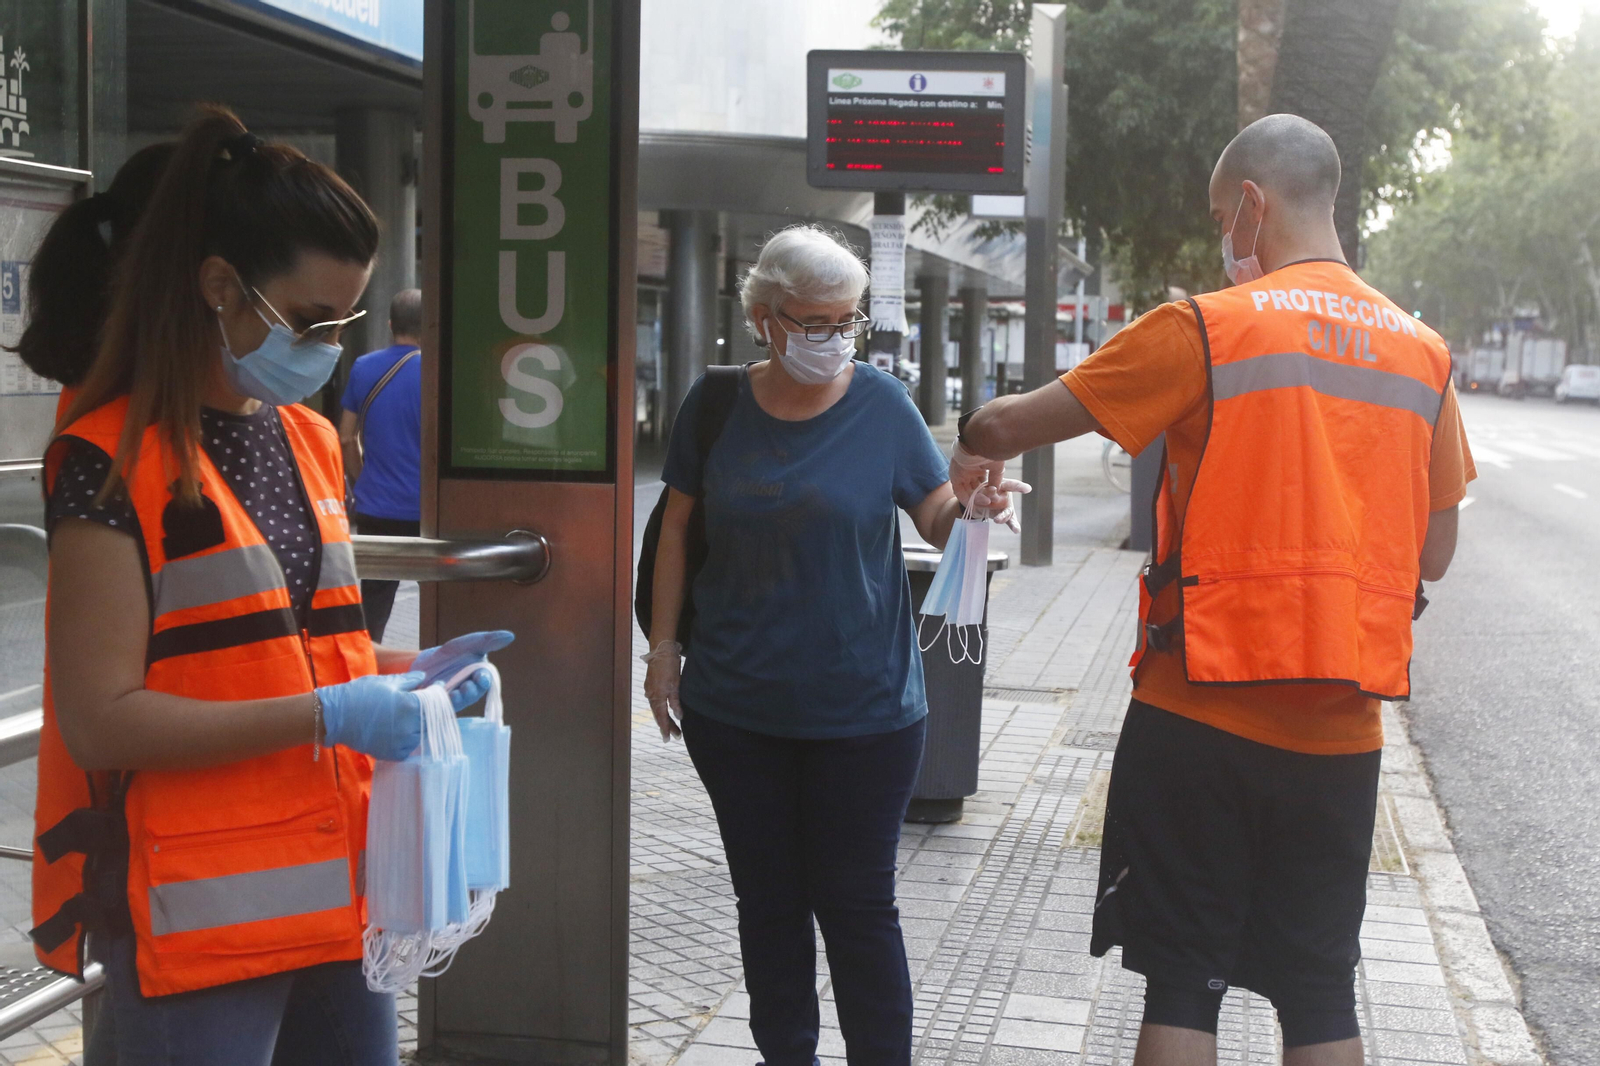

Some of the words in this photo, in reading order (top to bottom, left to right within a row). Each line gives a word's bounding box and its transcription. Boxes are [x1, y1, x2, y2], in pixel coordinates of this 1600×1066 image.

[853, 97, 887, 106] Próxima
[888, 98, 918, 108] llegada
[937, 100, 969, 109] destino
[498, 157, 566, 429] BUS
[1307, 320, 1378, 363] CIVIL
